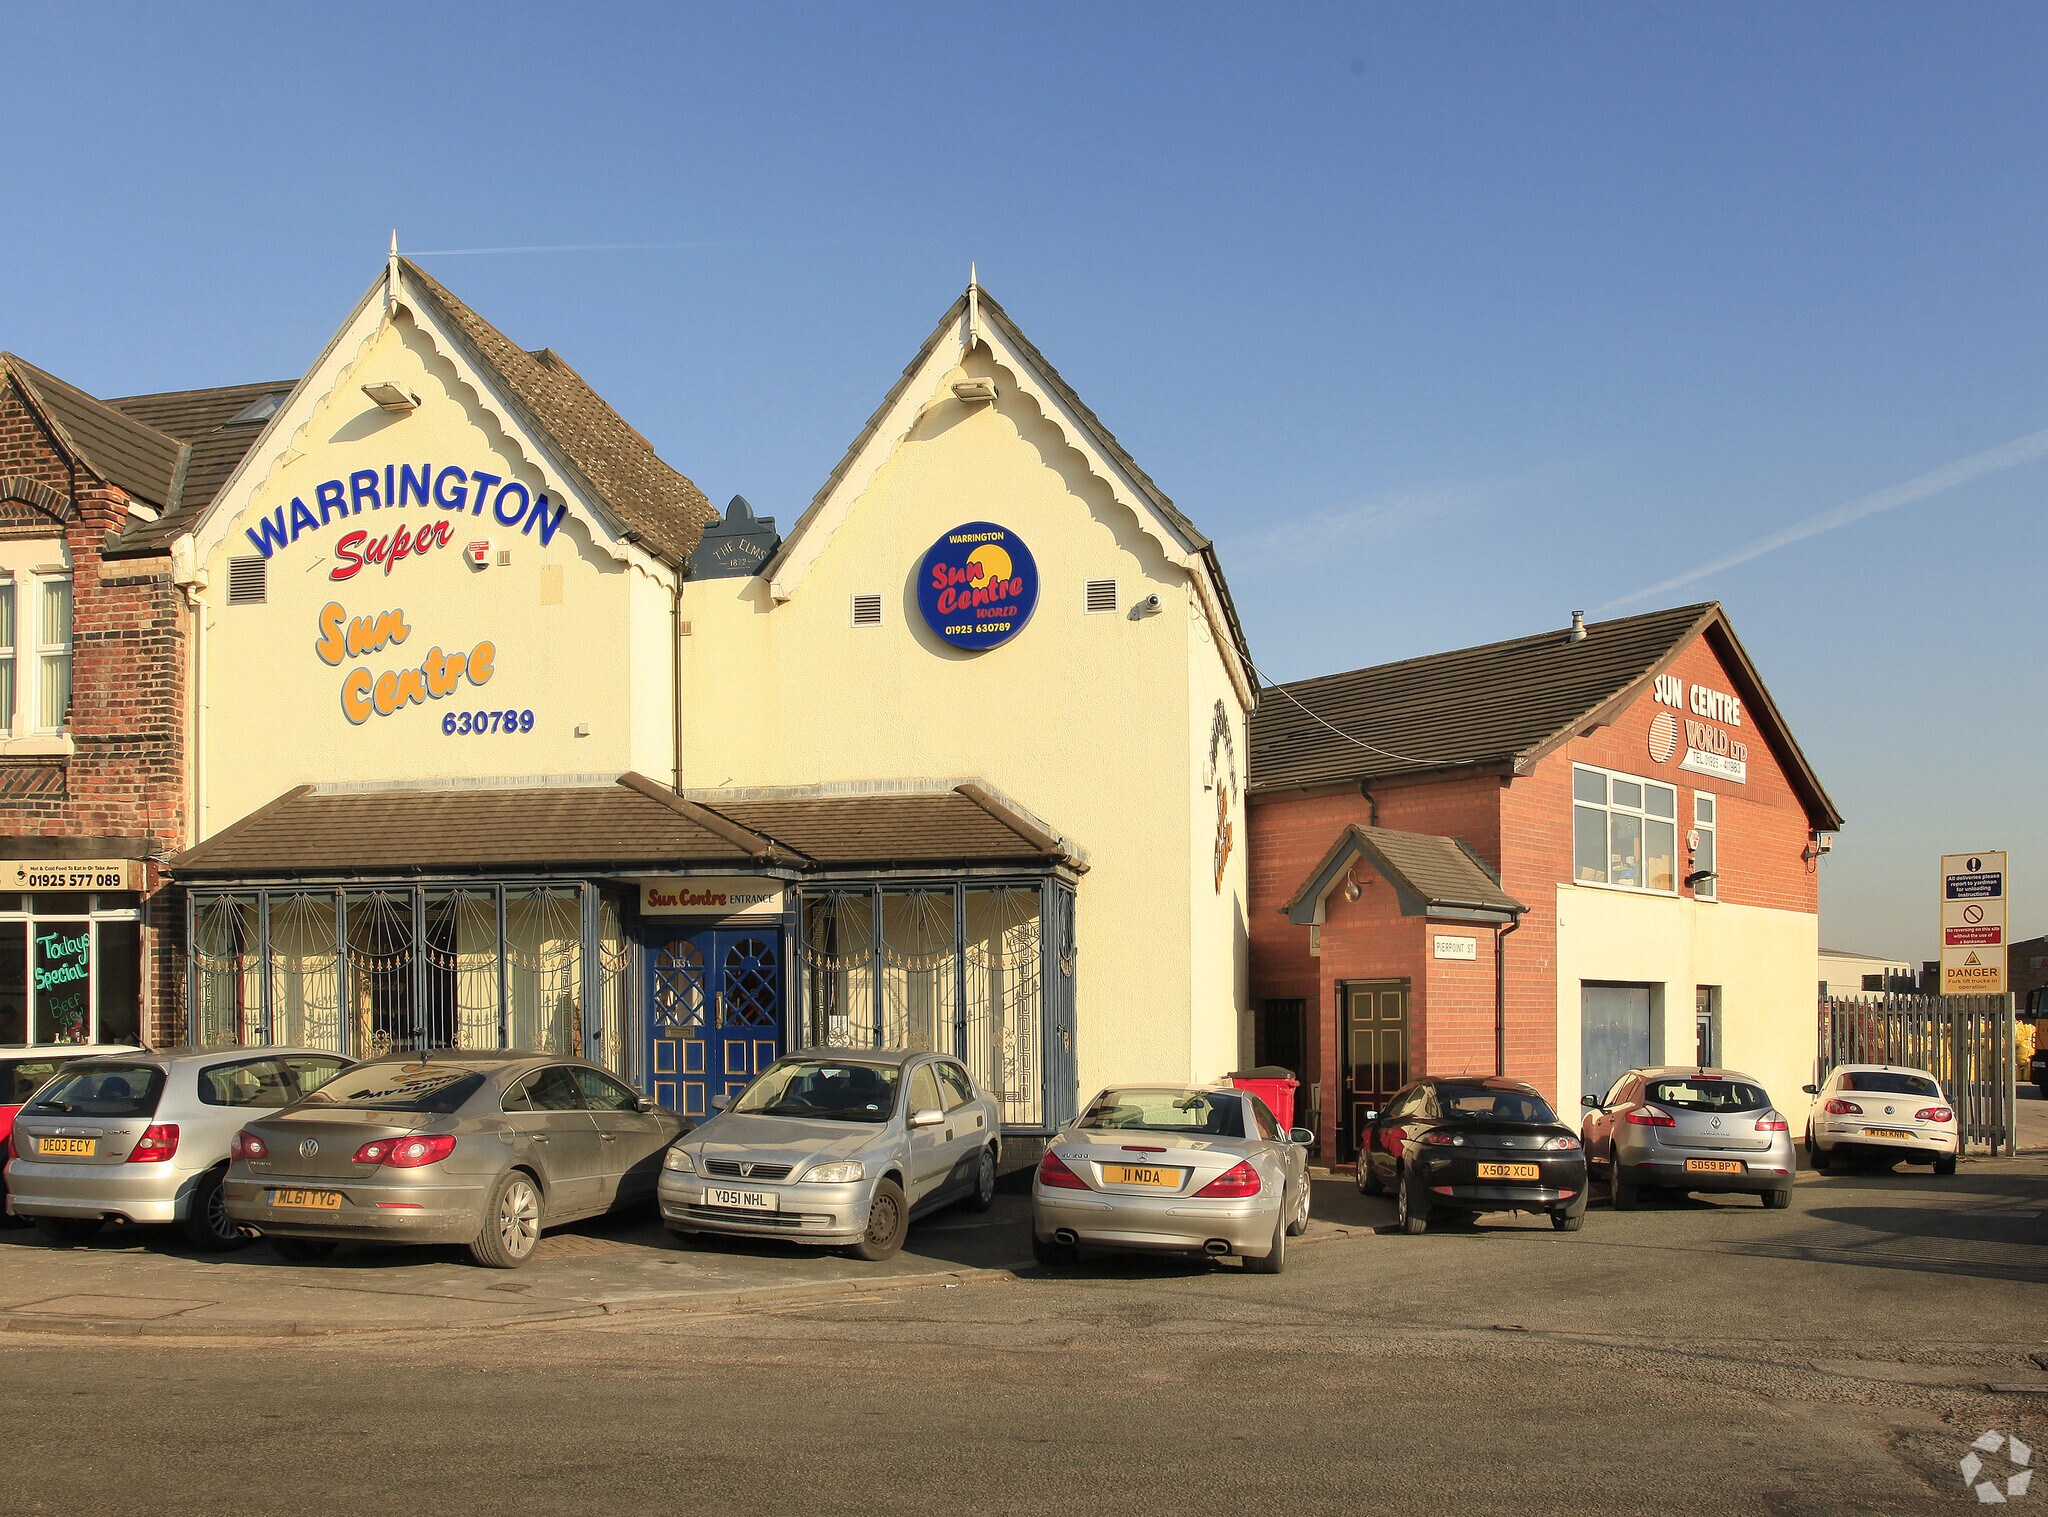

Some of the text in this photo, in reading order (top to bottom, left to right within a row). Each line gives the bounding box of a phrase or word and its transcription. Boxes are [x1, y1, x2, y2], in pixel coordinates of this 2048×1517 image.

[245, 463, 567, 559] WARRINGTON
[949, 532, 1004, 544] WARRINGTON
[329, 519, 455, 581] Super
[713, 538, 767, 561] THE ELMS
[932, 562, 984, 589] Sun
[937, 575, 1023, 615] Centre
[976, 605, 1018, 619] WORLD
[315, 601, 412, 667] Sun
[945, 622, 1011, 635] 01925 630789
[341, 641, 496, 725] Centre
[1653, 673, 1741, 727] SUN CENTRE
[442, 709, 535, 736] 630789
[1684, 718, 1748, 762] WORLD LTD
[29, 874, 121, 887] 01925 577 089
[1974, 879, 1997, 887] yardman
[1982, 873, 2000, 881] please
[1965, 885, 1991, 893] unloading
[648, 888, 774, 907] Sun Centre ENTRANCE
[36, 932, 90, 965] Todays
[673, 958, 686, 969] 133
[1947, 968, 1998, 978] DANGER
[43, 1139, 91, 1153] DE03 ECY
[1483, 1165, 1535, 1177] X502 XCU
[1691, 1160, 1738, 1171] SD59 BPY
[1134, 1169, 1160, 1184] NDA
[278, 1190, 337, 1207] ML61 TYG
[715, 1190, 767, 1206] YD51 NHL
